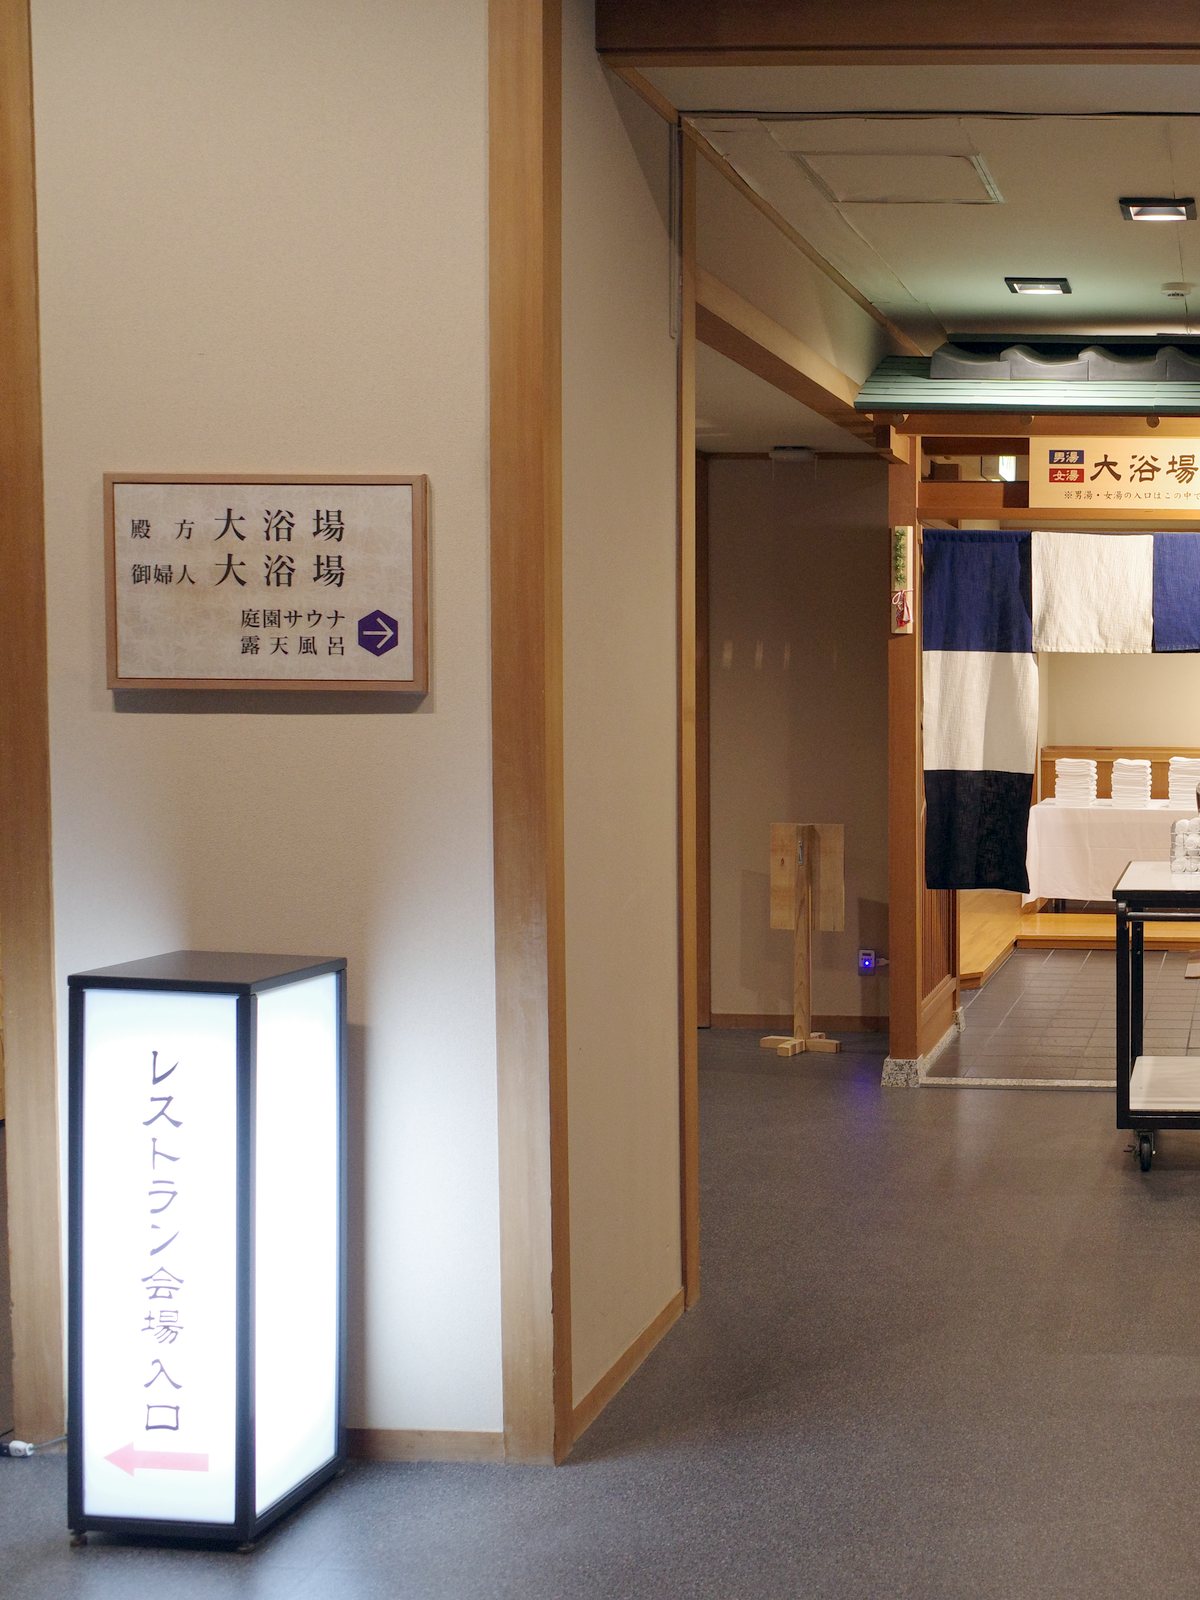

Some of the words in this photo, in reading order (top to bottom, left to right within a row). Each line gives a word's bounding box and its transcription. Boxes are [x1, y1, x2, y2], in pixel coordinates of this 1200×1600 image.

[1052, 451, 1080, 464] 男湯
[1052, 469, 1079, 482] 女湯
[213, 507, 346, 543] 大浴場
[131, 563, 197, 586] 御婦人
[213, 552, 346, 588] 大浴場
[240, 608, 346, 630] 庭園サウナ
[240, 635, 346, 657] 露天風呂
[141, 1050, 185, 1432] レストラン会場入口
